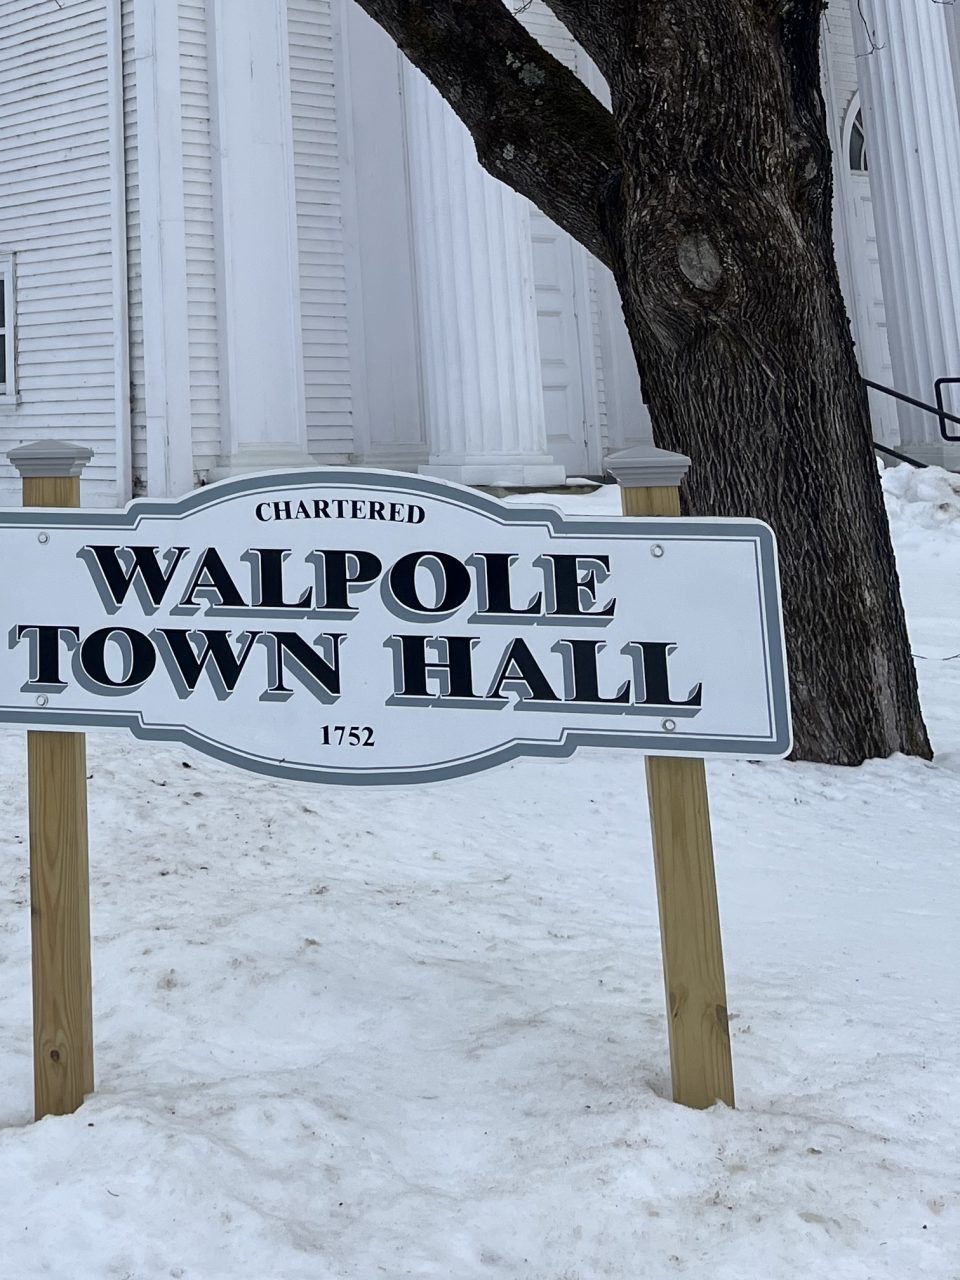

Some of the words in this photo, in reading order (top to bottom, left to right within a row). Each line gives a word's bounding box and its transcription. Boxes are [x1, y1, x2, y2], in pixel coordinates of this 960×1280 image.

[254, 499, 426, 525] CHARTERED
[77, 543, 617, 627] WALPOLE
[8, 624, 347, 702] TOWN
[385, 633, 703, 717] HALL
[320, 724, 376, 748] 1752
